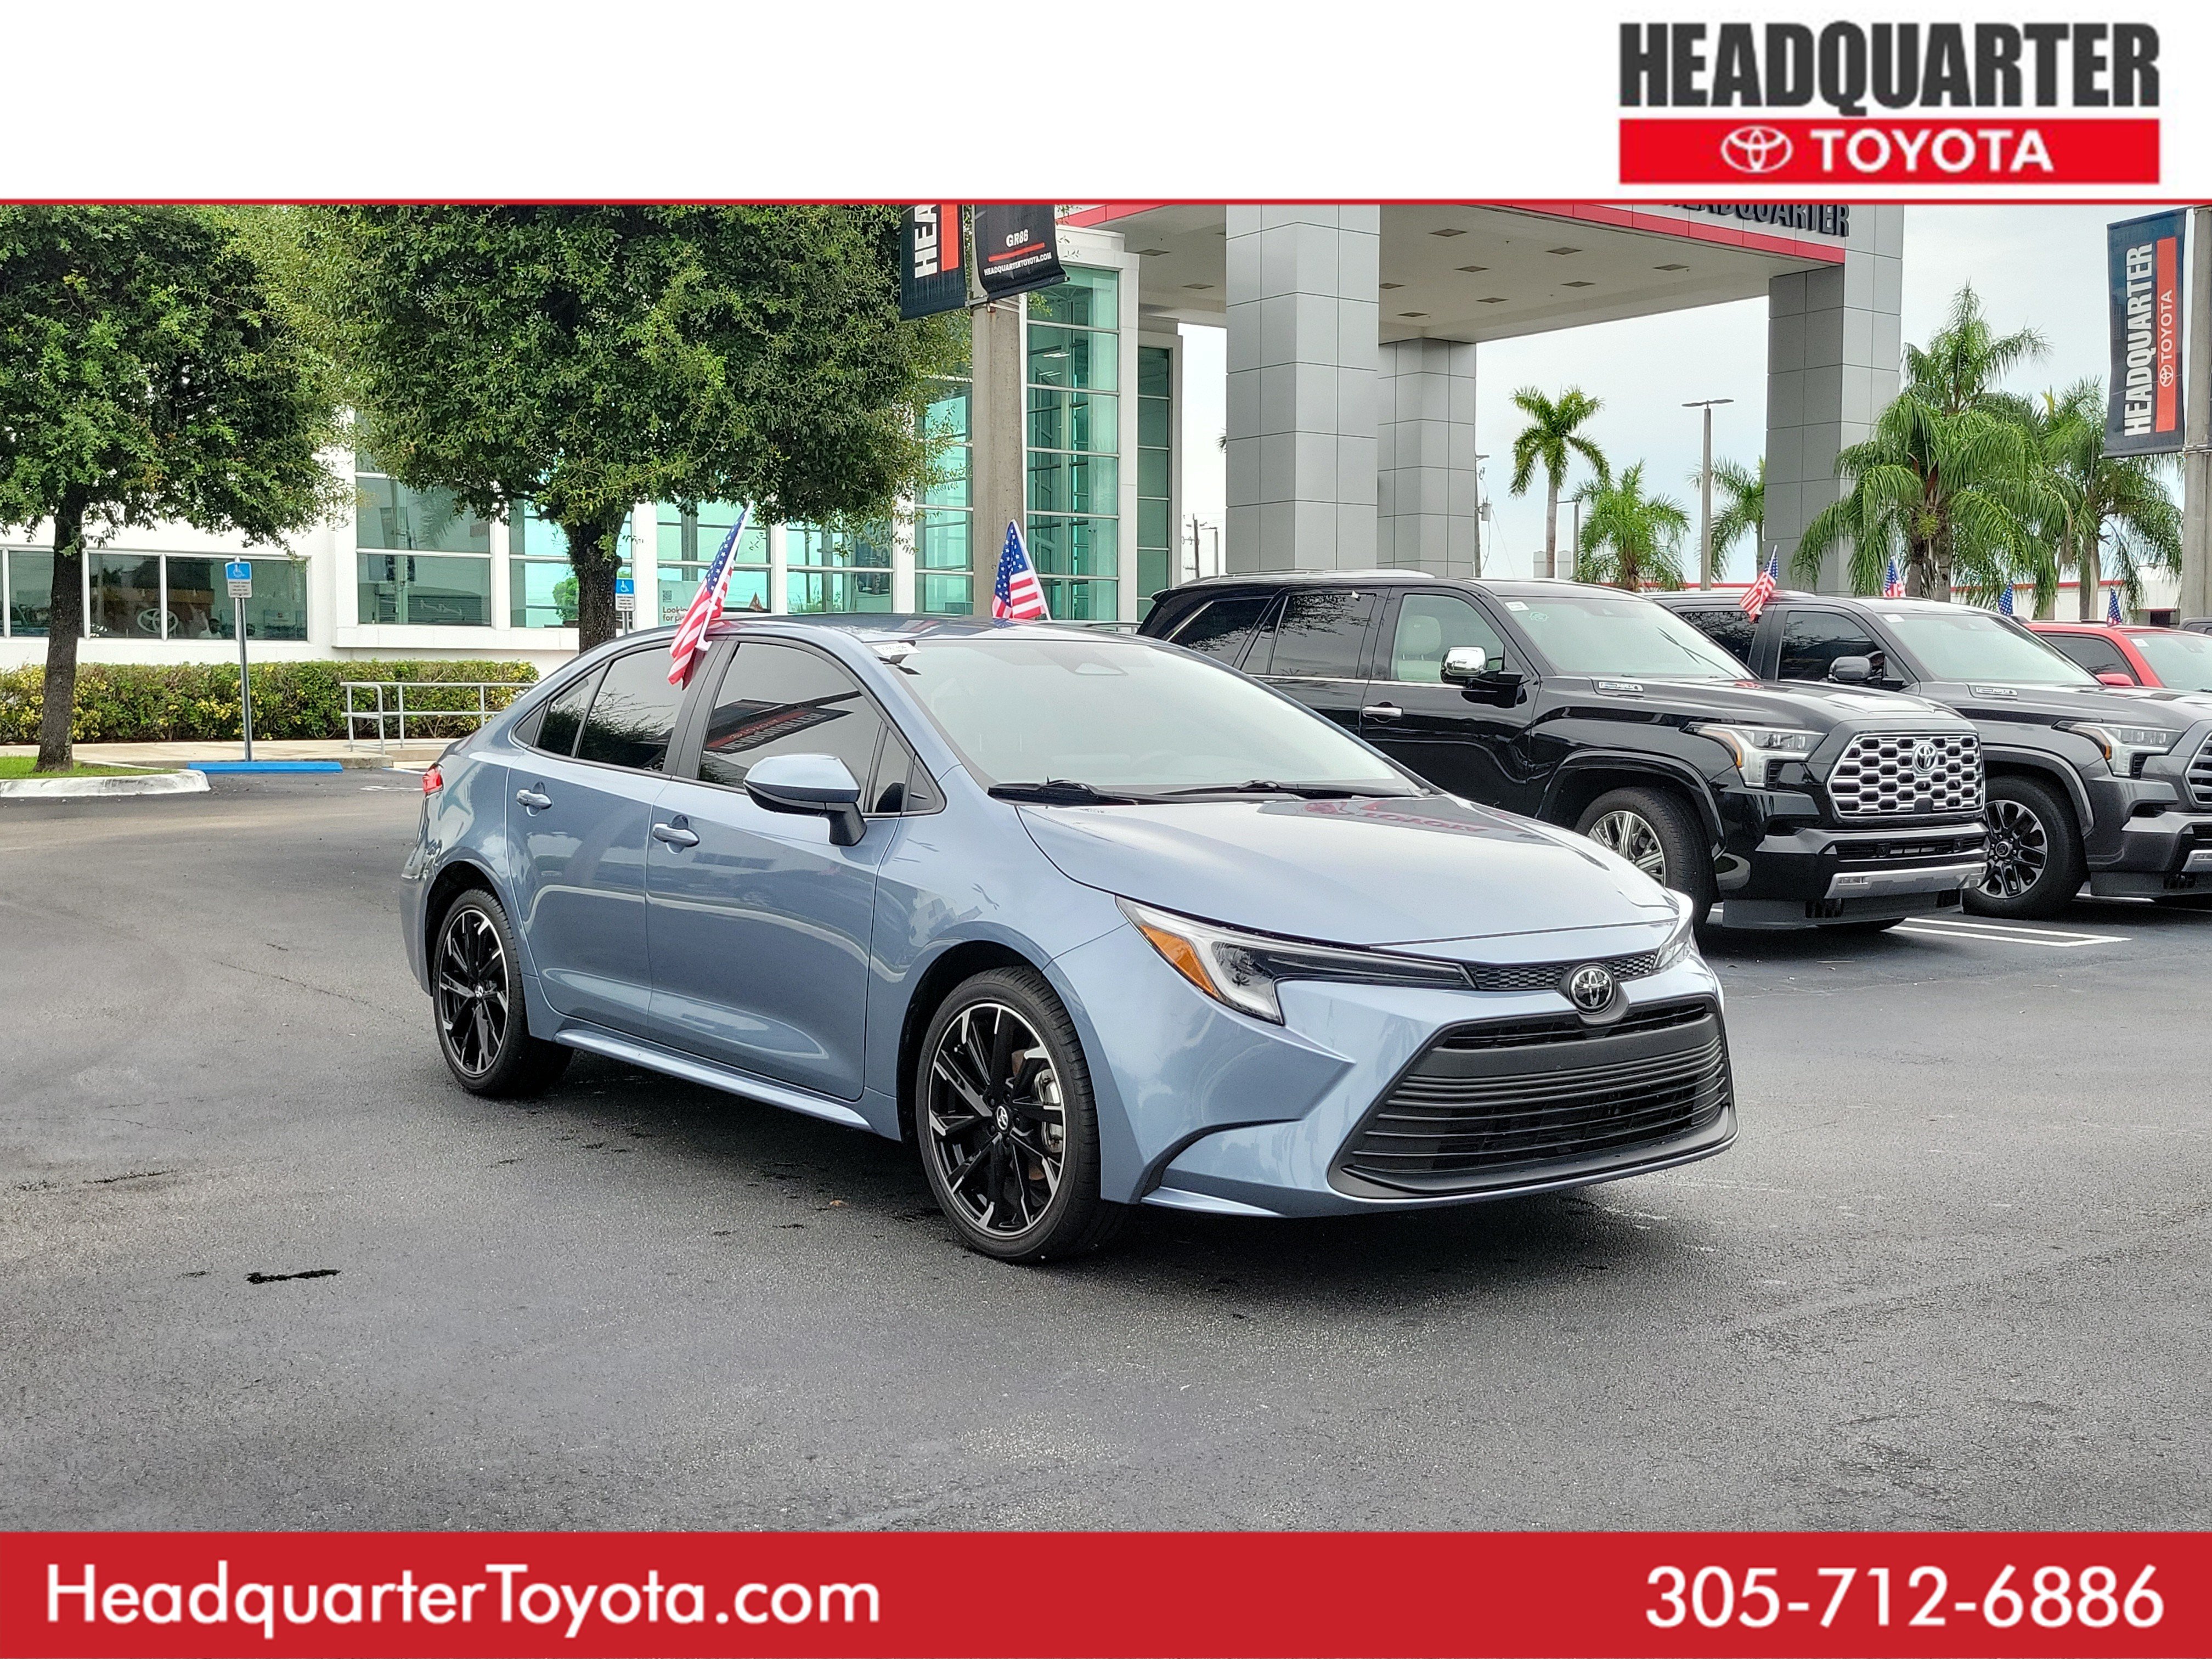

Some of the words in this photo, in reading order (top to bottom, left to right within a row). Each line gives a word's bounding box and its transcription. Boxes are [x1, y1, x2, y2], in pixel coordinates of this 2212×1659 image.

[1006, 229, 1028, 247] GR86
[984, 252, 1052, 276] HEADQUARTERTOYOTA.COM
[2124, 243, 2156, 437] HEADQUARTER
[2160, 290, 2173, 363] TOYOTA
